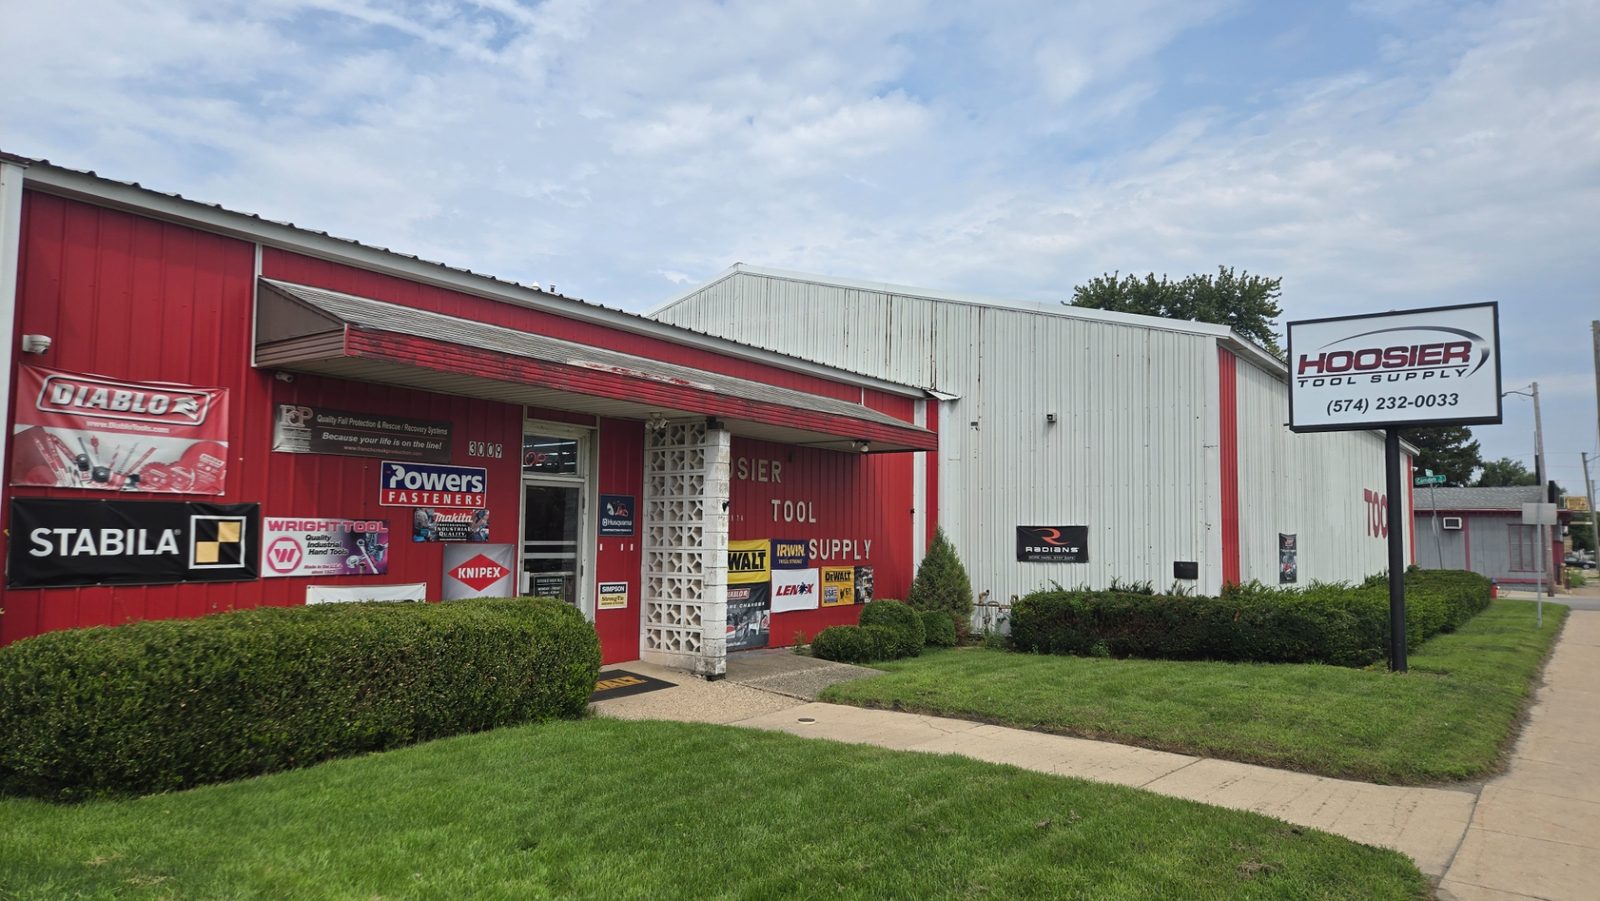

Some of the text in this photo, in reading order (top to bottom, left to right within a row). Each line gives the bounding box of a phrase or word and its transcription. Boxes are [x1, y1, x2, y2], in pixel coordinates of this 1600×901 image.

[1298, 341, 1472, 375] HOOSIER
[1298, 368, 1467, 388] TOOL SUPPLY
[50, 383, 170, 415] DIABLO
[1326, 393, 1459, 416] (574) 232-0033
[317, 414, 336, 426] Quality
[337, 417, 348, 425] Fall
[349, 418, 376, 429] Protection
[382, 421, 400, 431] Rescue
[404, 423, 427, 435] Recovery
[428, 425, 448, 436] Systems
[322, 432, 359, 442] Because
[360, 437, 379, 445] your
[379, 437, 392, 446] life
[413, 440, 425, 448] the
[426, 441, 442, 450] line!
[469, 440, 503, 458] 3009
[389, 464, 484, 493] Powers
[729, 457, 782, 483] SIER
[388, 491, 482, 506] FASTENERS
[771, 499, 817, 524] TOOL
[1364, 488, 1388, 539] TOO
[268, 520, 389, 533] WRIGHT TOOL
[305, 534, 332, 542] Quality
[777, 543, 805, 557] IRWIN
[808, 538, 872, 560] SUPPLY
[728, 551, 766, 570] WALT
[458, 566, 500, 578] KNIPEX
[602, 585, 625, 593] SIMPSON
